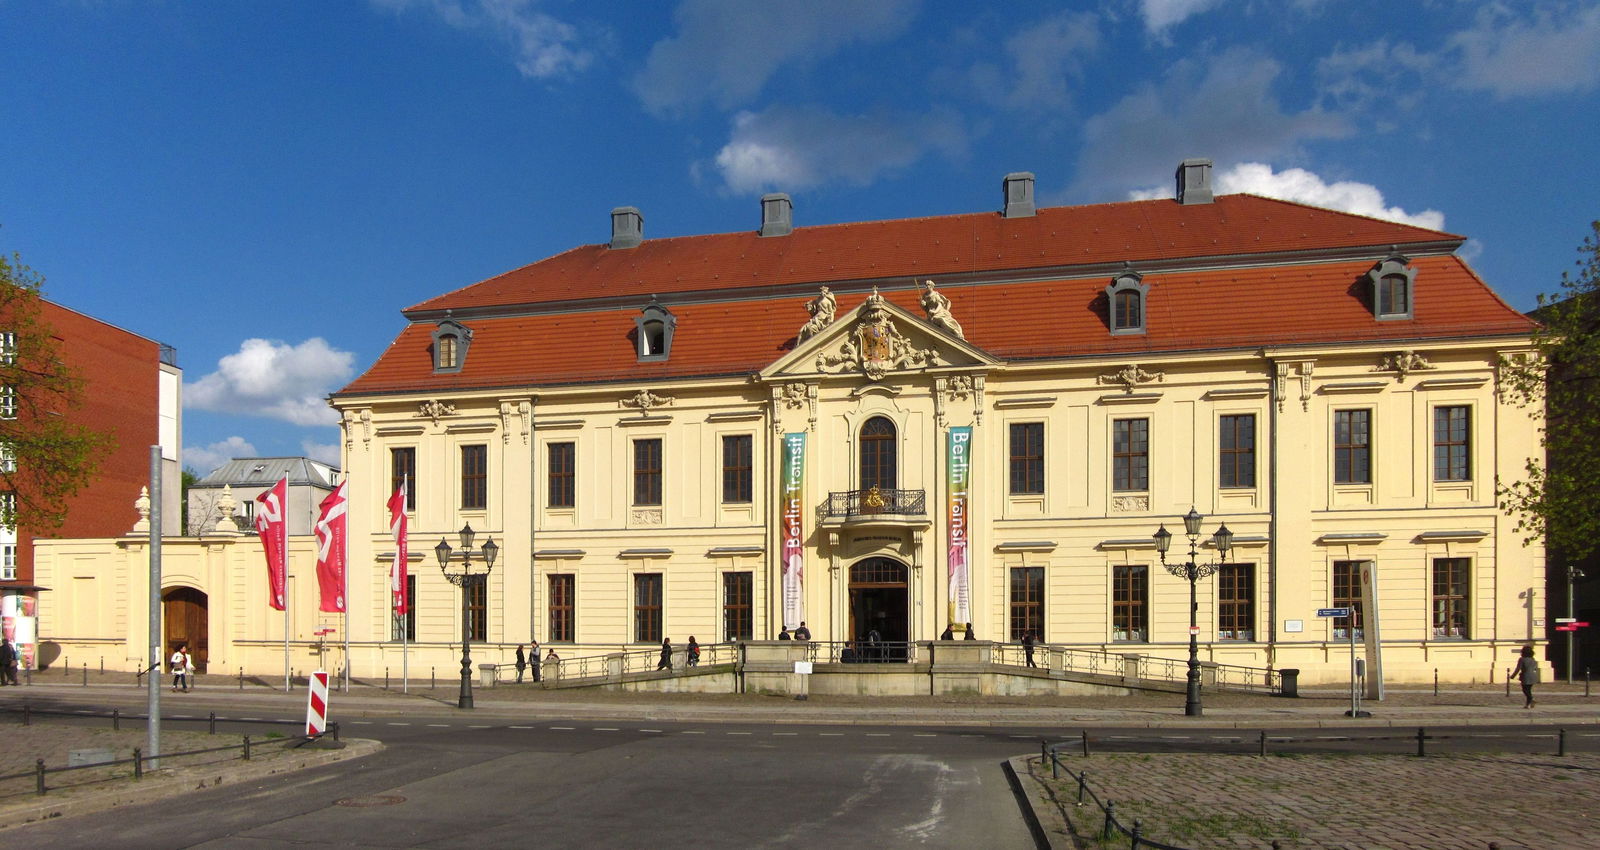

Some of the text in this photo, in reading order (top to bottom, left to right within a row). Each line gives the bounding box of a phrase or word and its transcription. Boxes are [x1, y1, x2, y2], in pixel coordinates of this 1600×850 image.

[785, 437, 802, 548] Berlin Transit
[952, 432, 969, 484] Berlin
